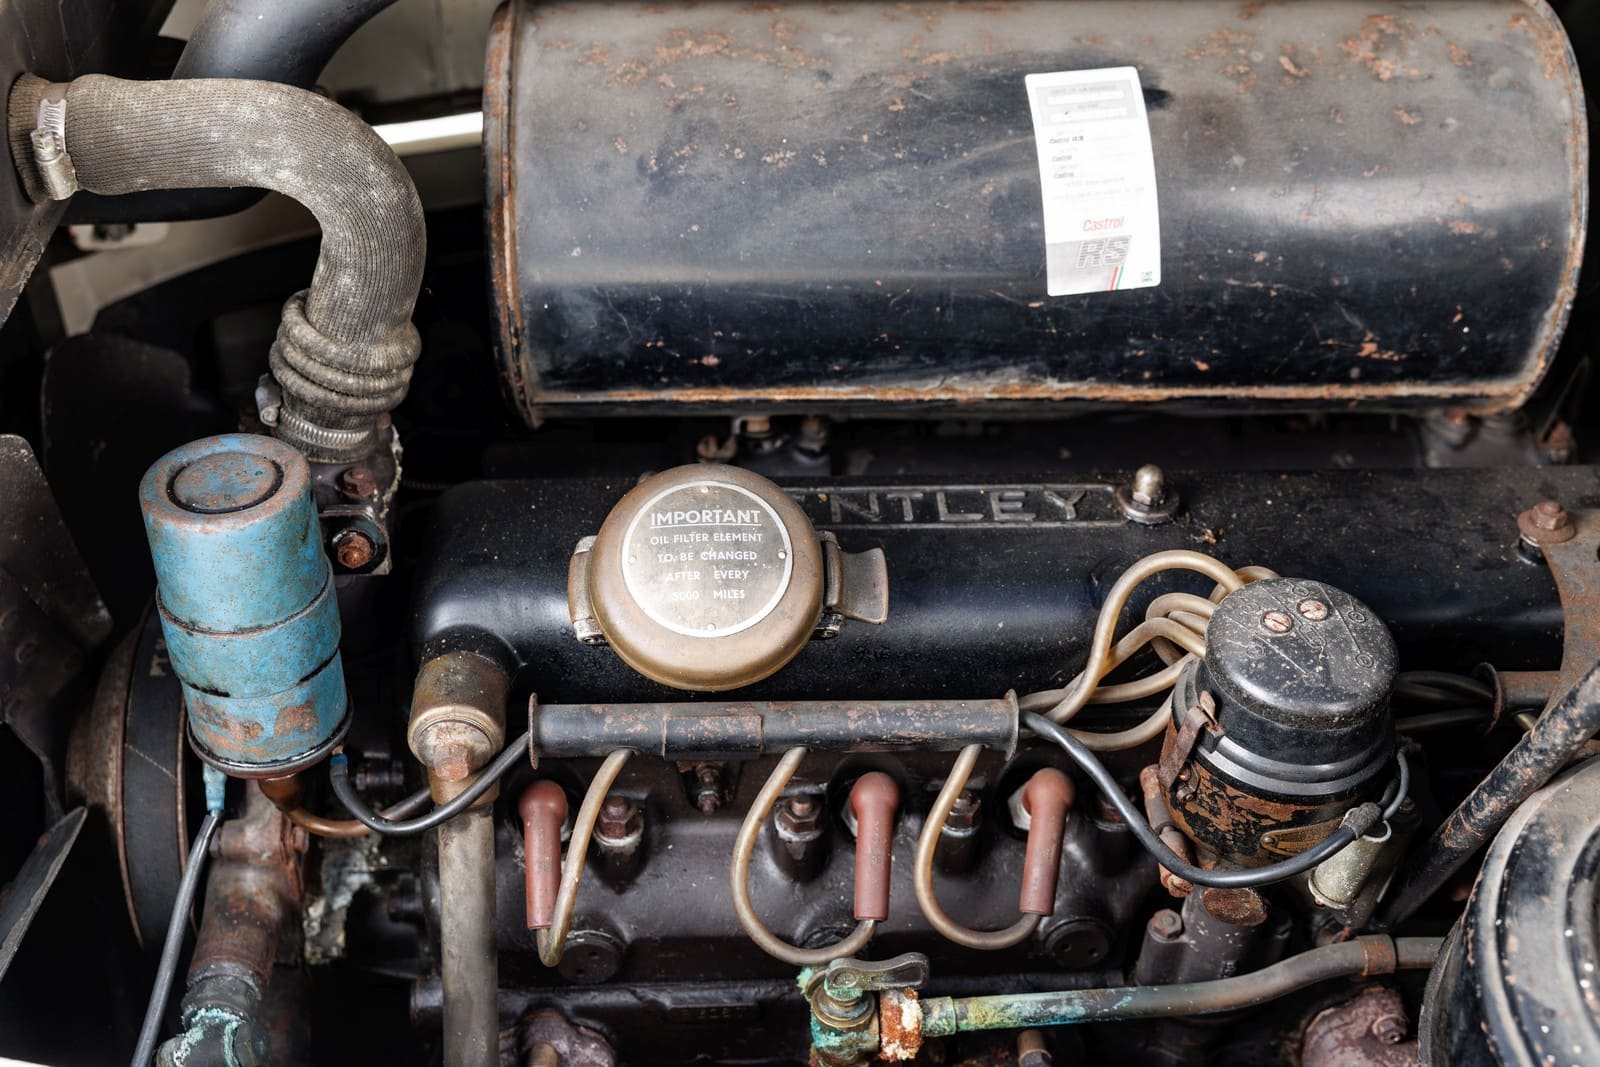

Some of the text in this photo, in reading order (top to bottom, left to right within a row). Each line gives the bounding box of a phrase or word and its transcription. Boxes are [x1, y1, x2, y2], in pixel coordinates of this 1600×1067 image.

[1083, 216, 1125, 232] Castrol
[794, 489, 1087, 522] NTLEY
[651, 509, 761, 526] IMPORTANT
[650, 532, 763, 545] OIL FILTER ELEMENT
[657, 550, 758, 563] TO BE CHANGED
[666, 570, 750, 582] AFTER EVERY
[672, 589, 745, 601] 5000 MILES
